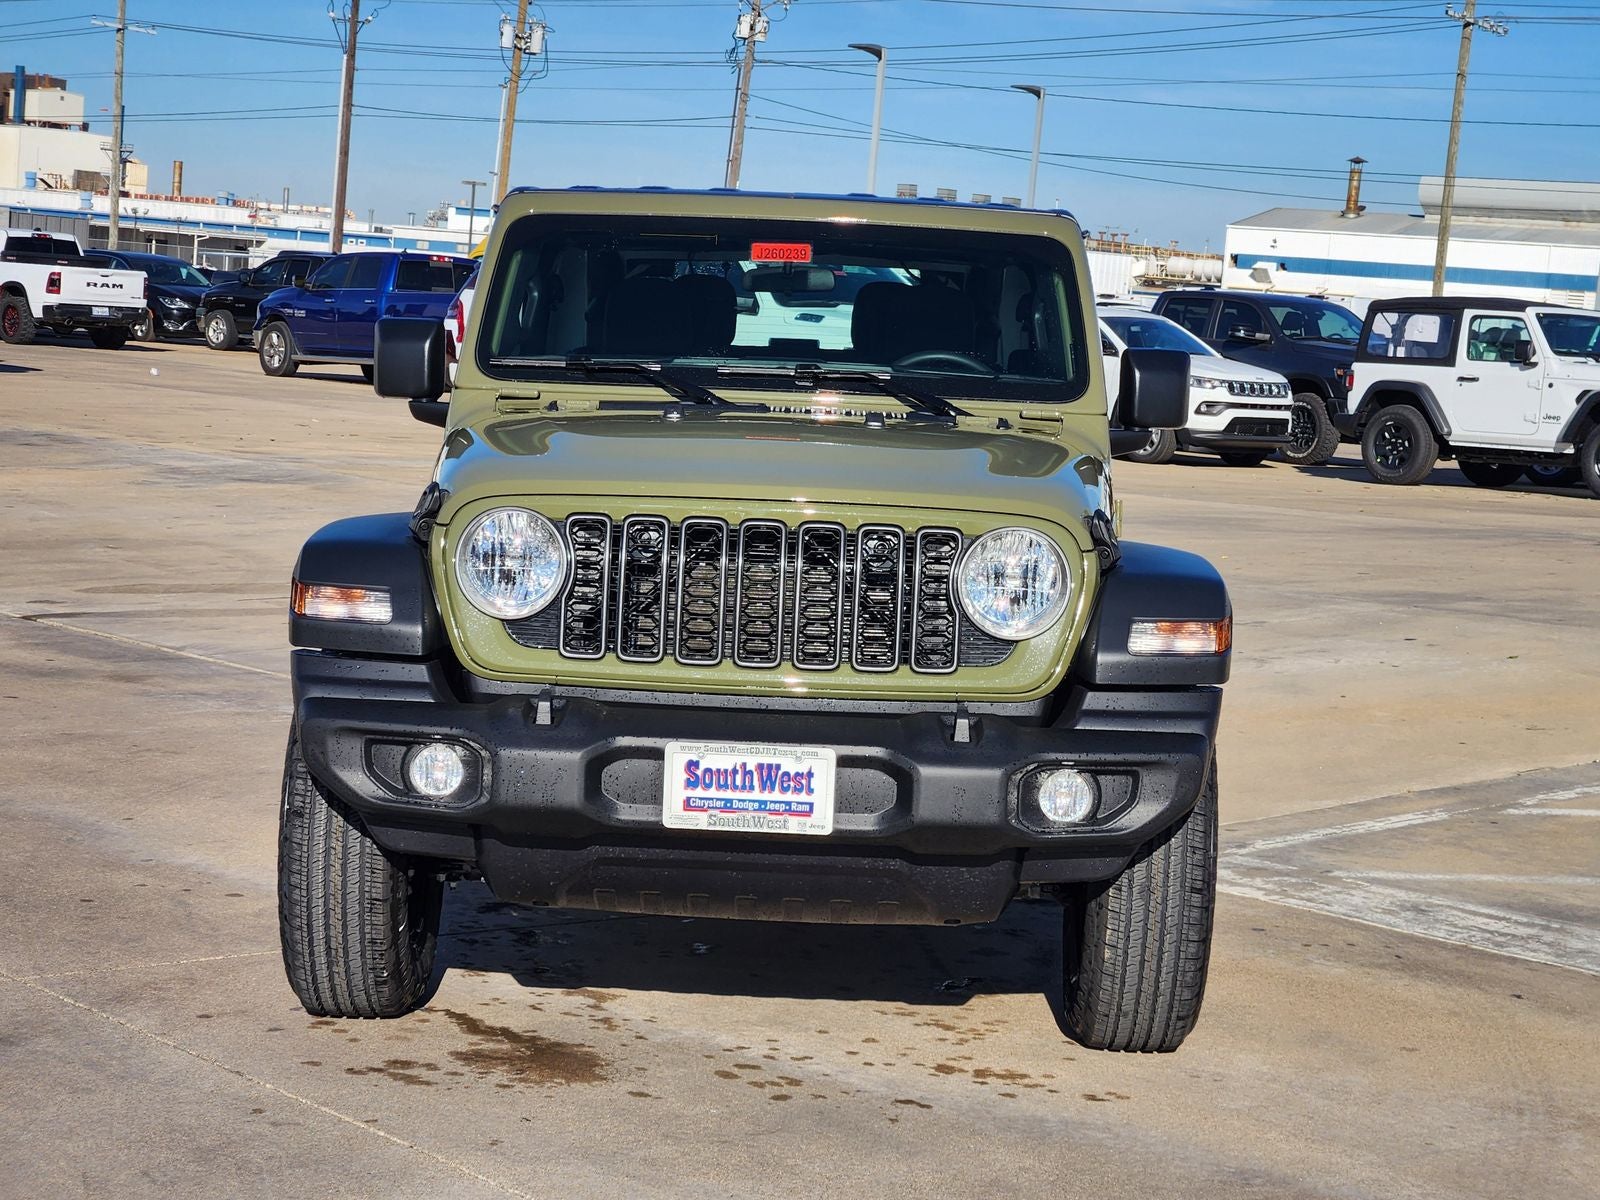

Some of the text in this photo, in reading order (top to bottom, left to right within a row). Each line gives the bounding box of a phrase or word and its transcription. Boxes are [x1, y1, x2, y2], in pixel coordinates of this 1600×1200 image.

[757, 248, 807, 260] J260239
[86, 281, 124, 289] RAM
[1542, 413, 1561, 421] Jeep
[689, 798, 725, 809] Chrysler
[732, 800, 759, 811] Dodge
[791, 803, 810, 812] Ram
